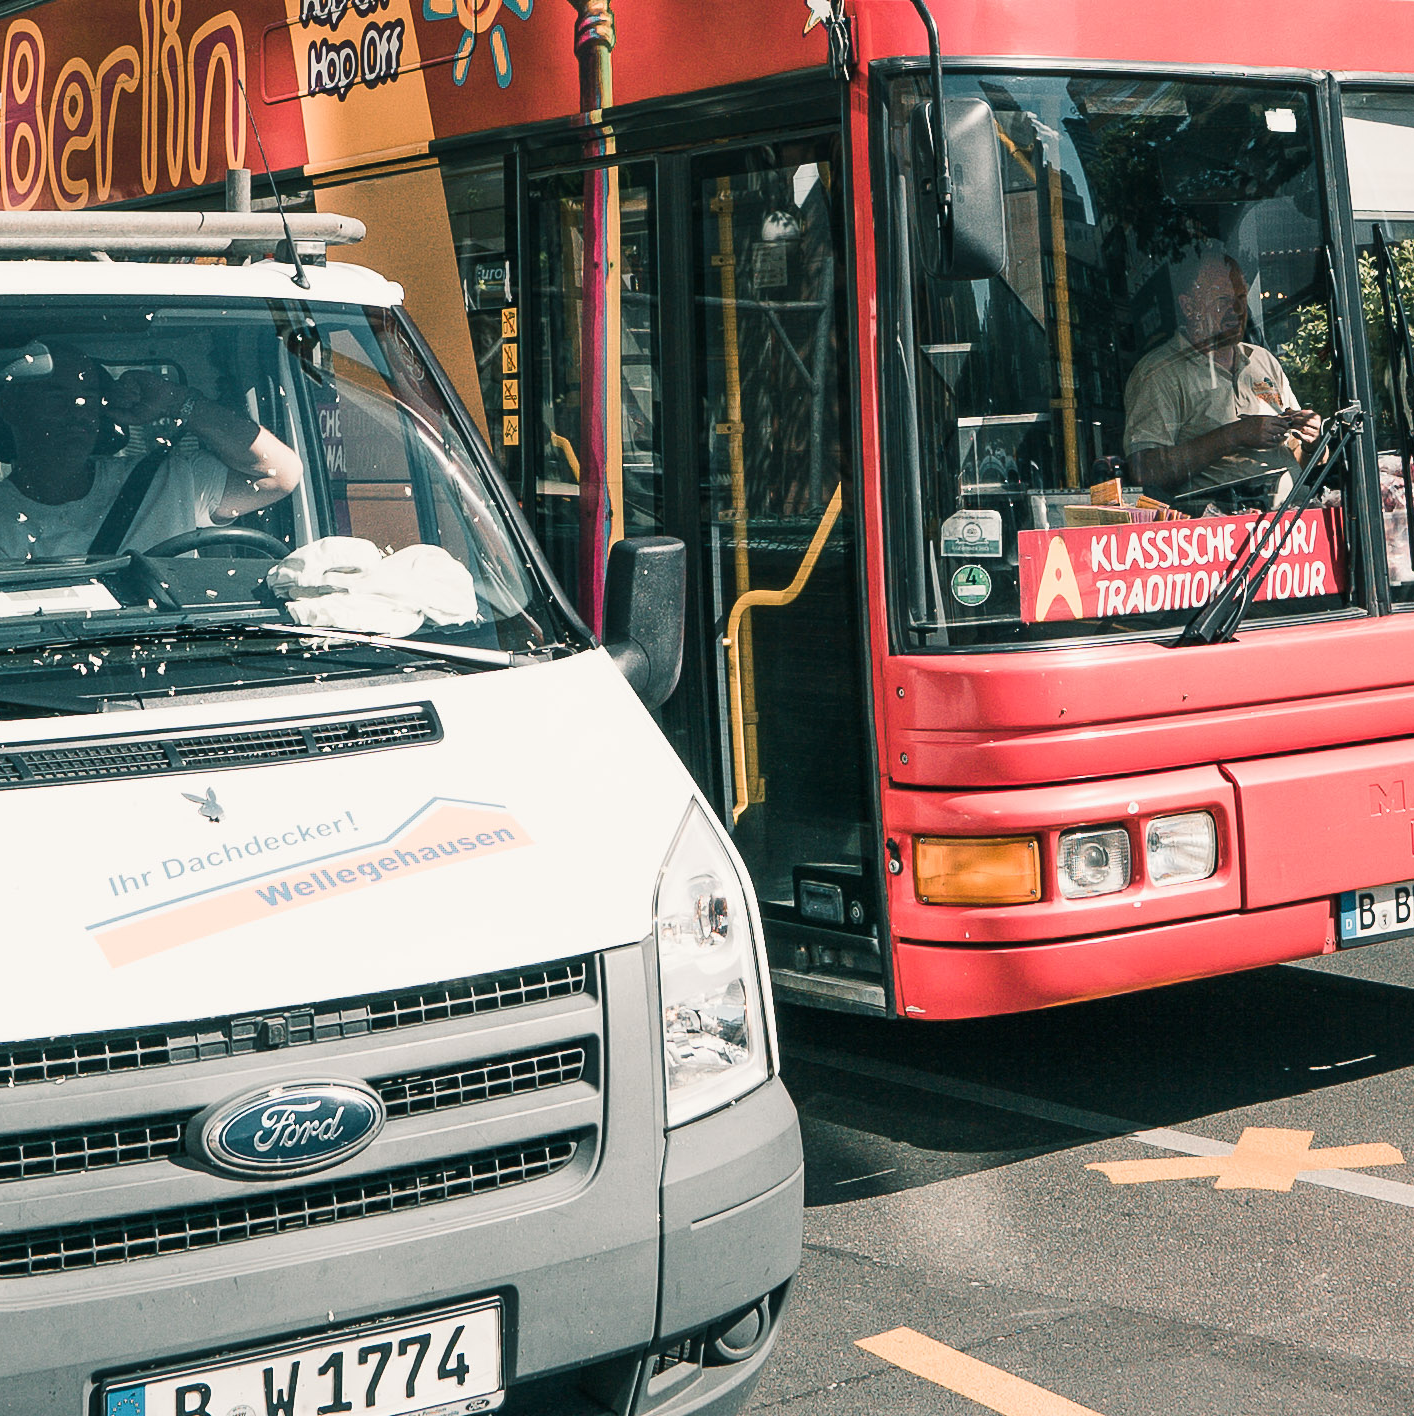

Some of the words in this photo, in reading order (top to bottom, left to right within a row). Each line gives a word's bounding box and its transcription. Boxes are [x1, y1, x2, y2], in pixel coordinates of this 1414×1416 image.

[308, 37, 359, 103] Hop
[360, 17, 405, 90] Off
[1035, 535, 1084, 623] A
[1090, 523, 1237, 573] KLASSISCHE
[1267, 560, 1326, 600] TOUR
[108, 866, 153, 897] Ihr
[160, 810, 360, 881] Dachdecker!
[254, 825, 516, 907] Wellegehausen
[1358, 892, 1376, 931] B
[253, 1099, 345, 1153] Ford
